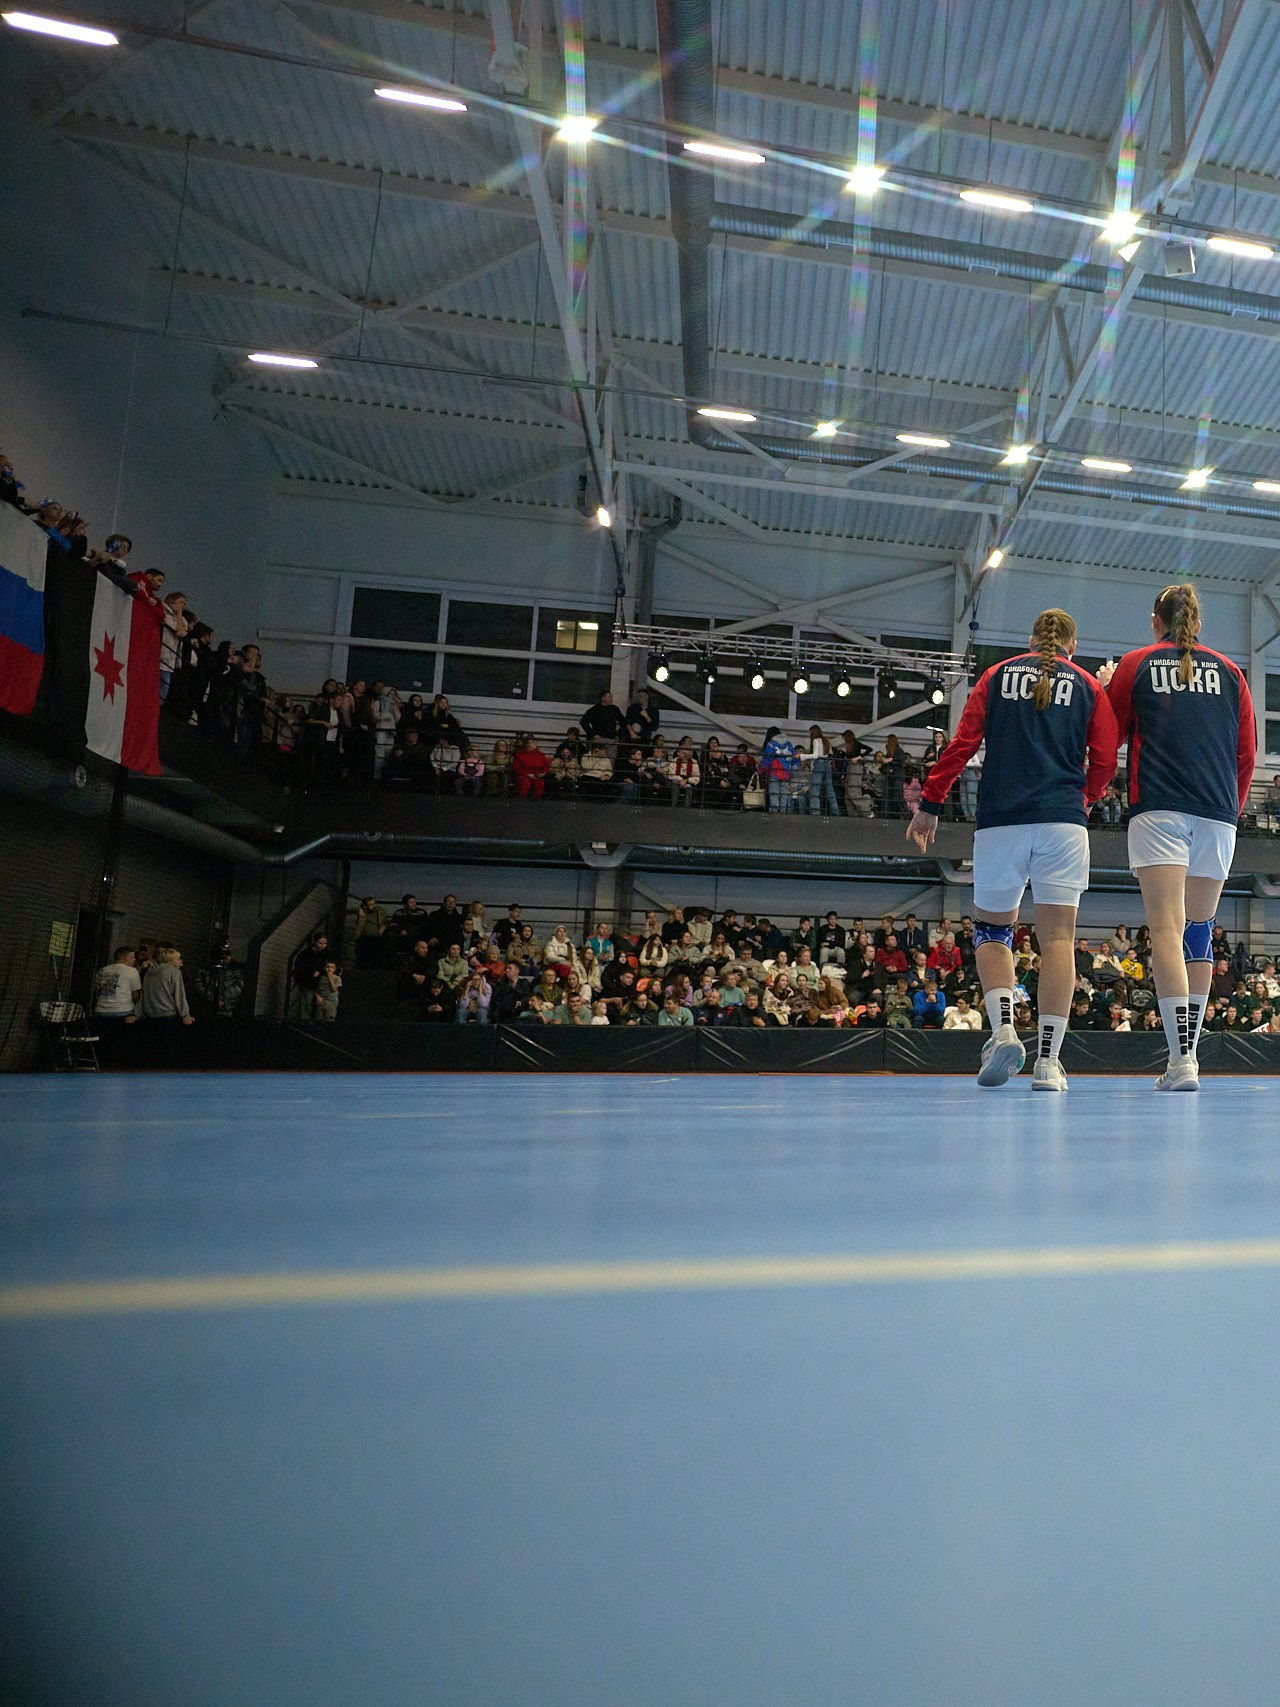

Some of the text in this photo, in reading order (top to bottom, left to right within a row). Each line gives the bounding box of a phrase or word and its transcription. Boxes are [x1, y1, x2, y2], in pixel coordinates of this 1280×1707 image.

[1201, 661, 1219, 669] КЛУБ
[1057, 671, 1075, 680] КЛУБ
[1150, 666, 1221, 695] ЦСКА
